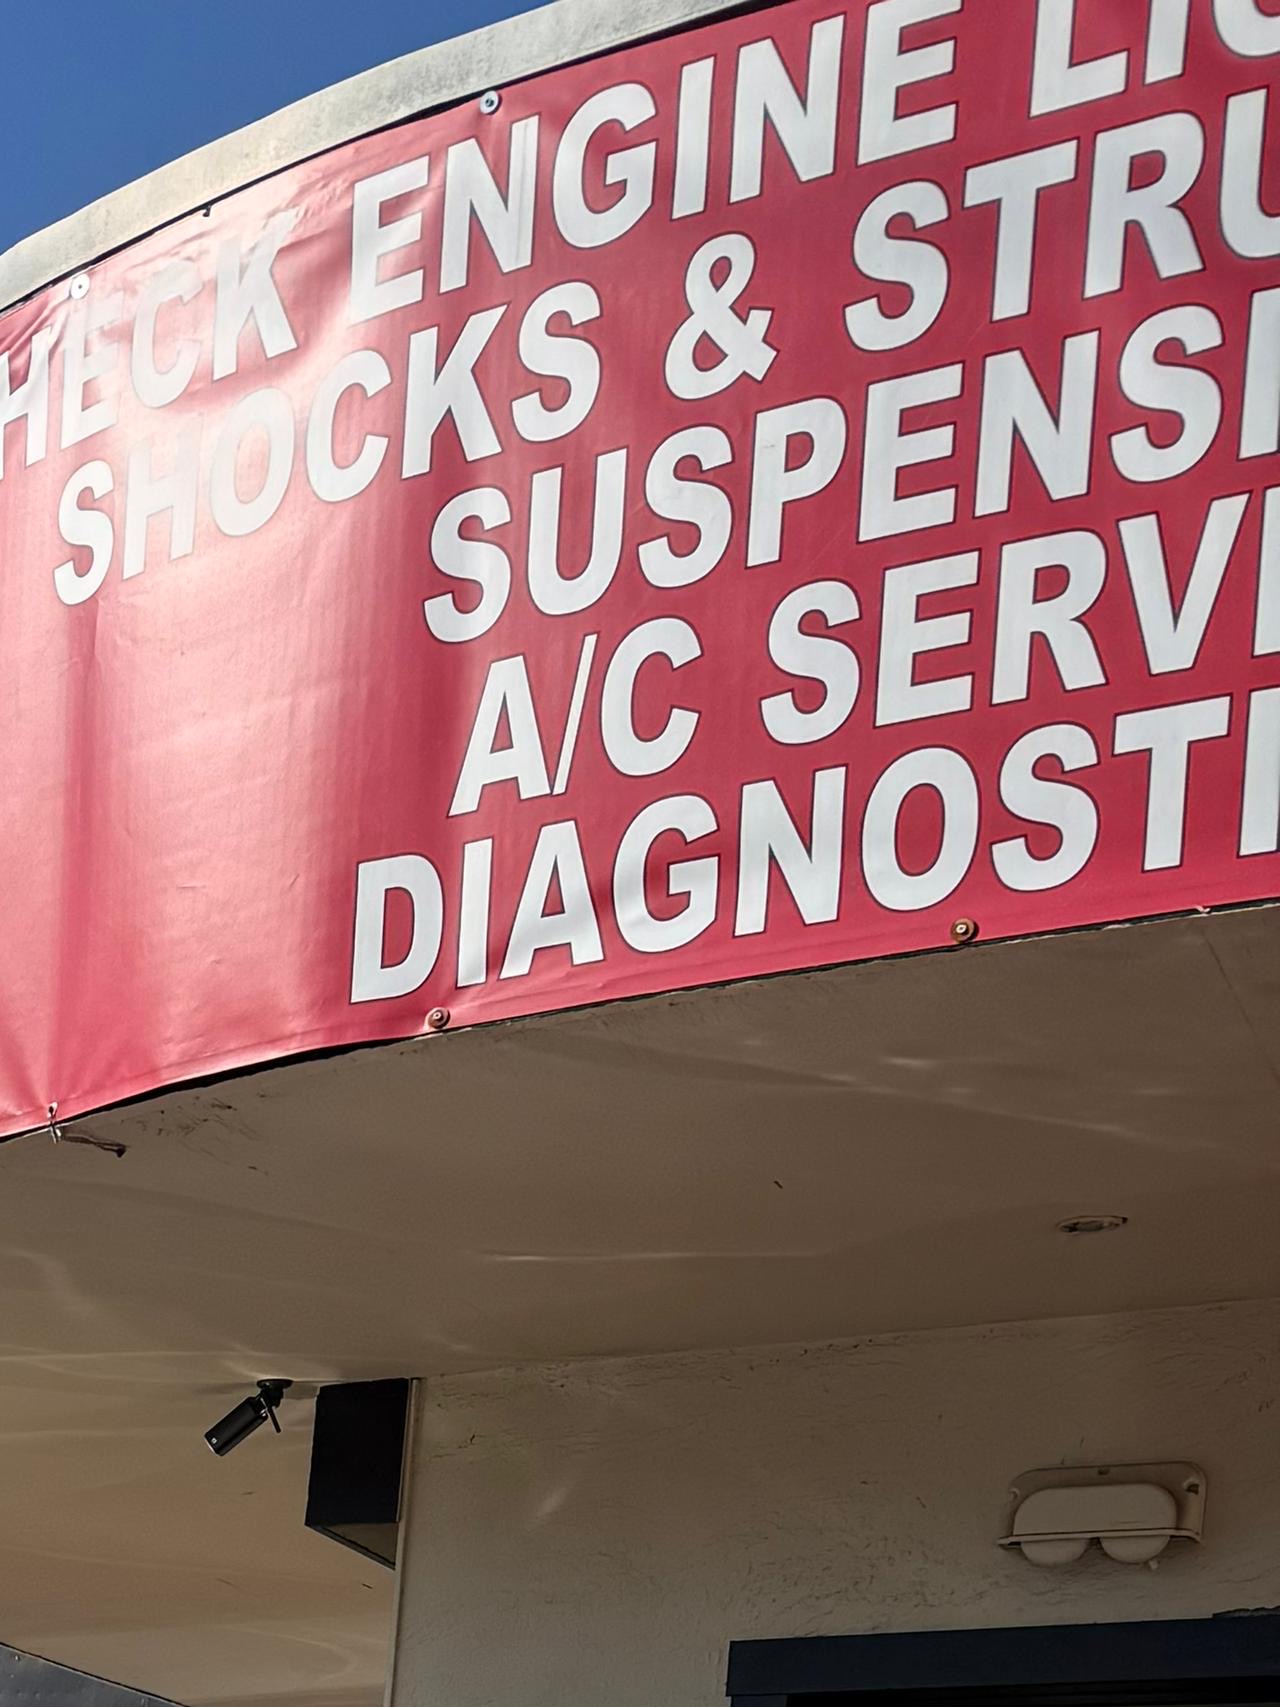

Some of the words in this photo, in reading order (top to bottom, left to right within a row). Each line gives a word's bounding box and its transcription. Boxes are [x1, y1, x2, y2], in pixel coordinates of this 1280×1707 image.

[347, 0, 963, 325] ENGINE
[53, 280, 604, 608] SHOCKS
[662, 232, 778, 401] &
[446, 615, 705, 818] A/C
